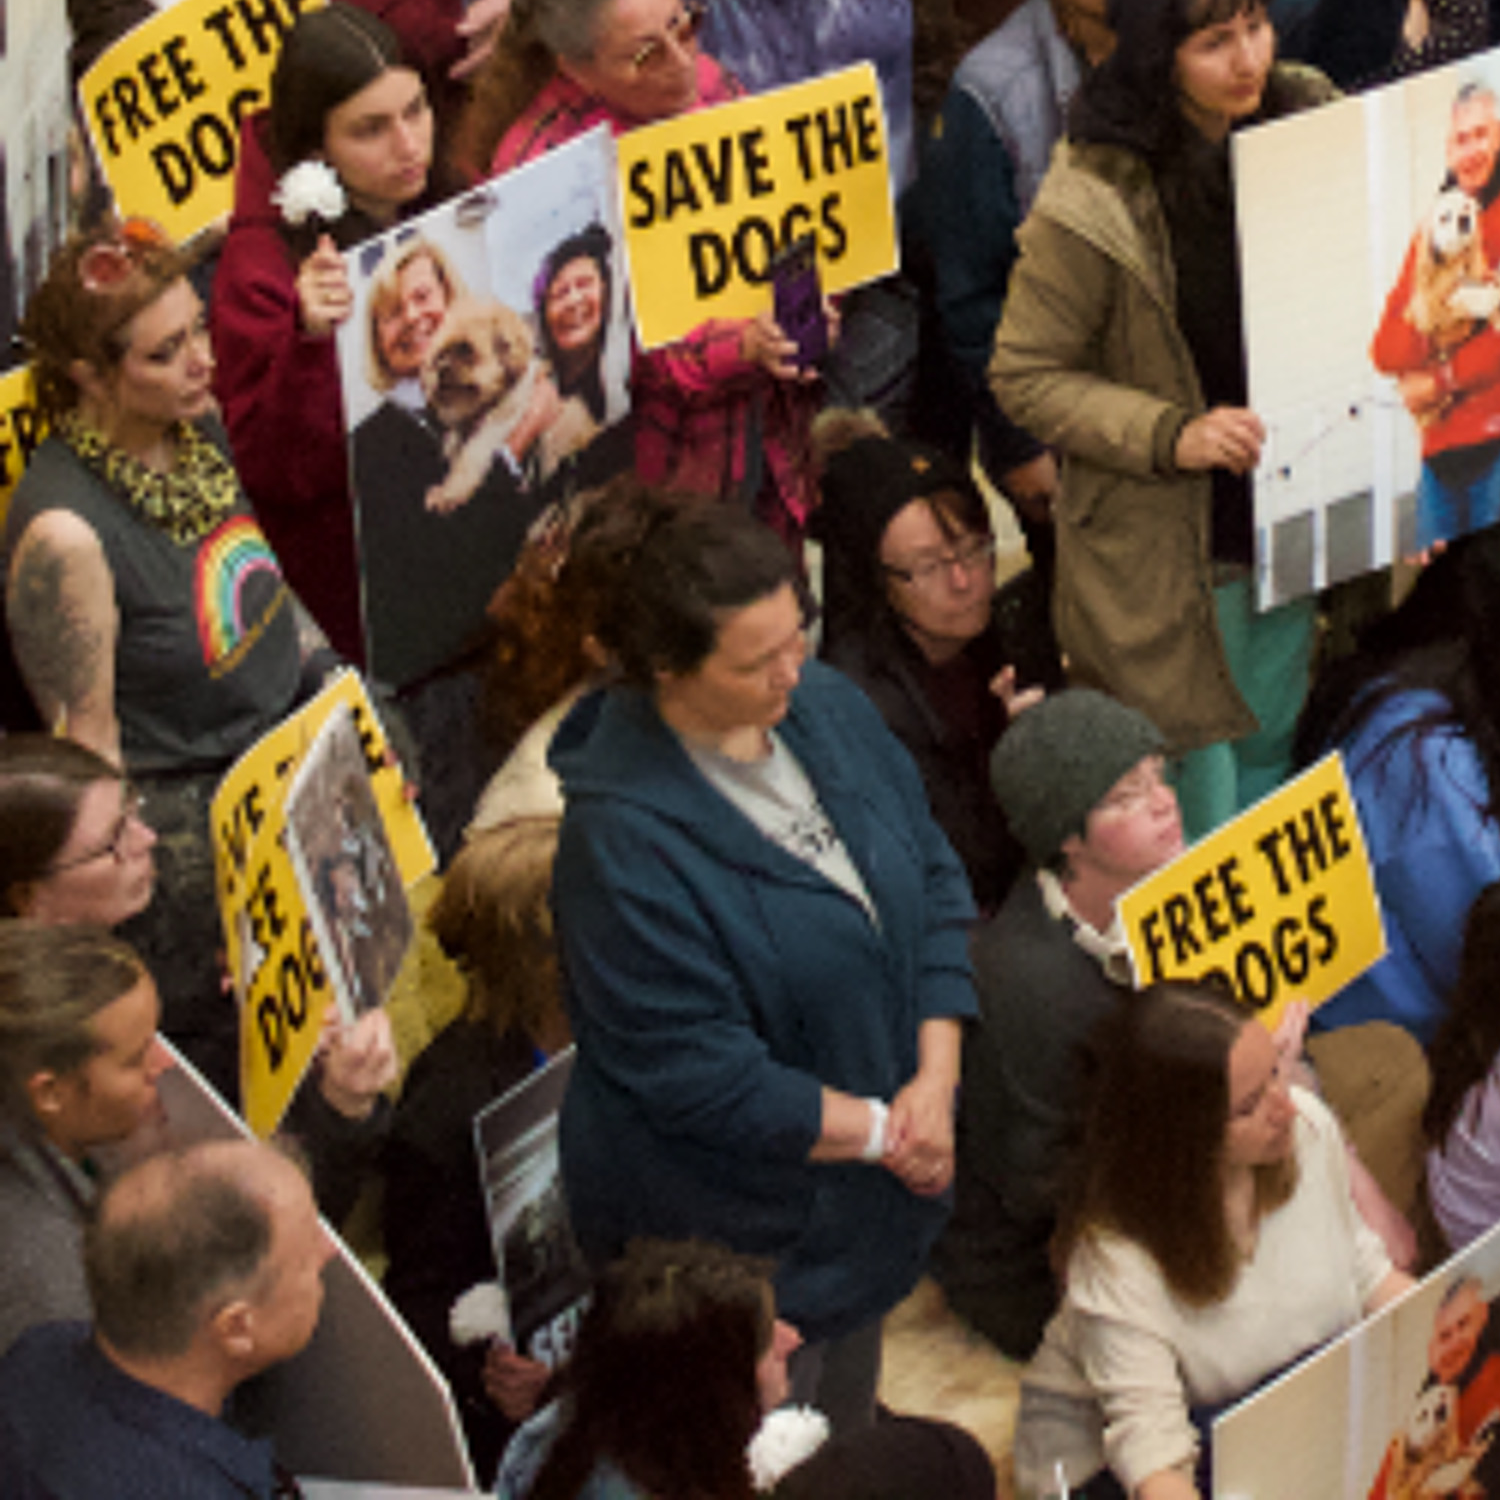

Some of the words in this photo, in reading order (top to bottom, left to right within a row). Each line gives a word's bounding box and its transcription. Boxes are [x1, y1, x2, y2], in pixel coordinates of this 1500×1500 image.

[94, 34, 207, 156] FREE
[149, 88, 264, 211] DO
[628, 126, 775, 230] SAVE
[785, 95, 881, 184] THE
[1140, 854, 1255, 982] FREE
[1255, 790, 1351, 897] THE
[257, 915, 327, 1076] DOG
